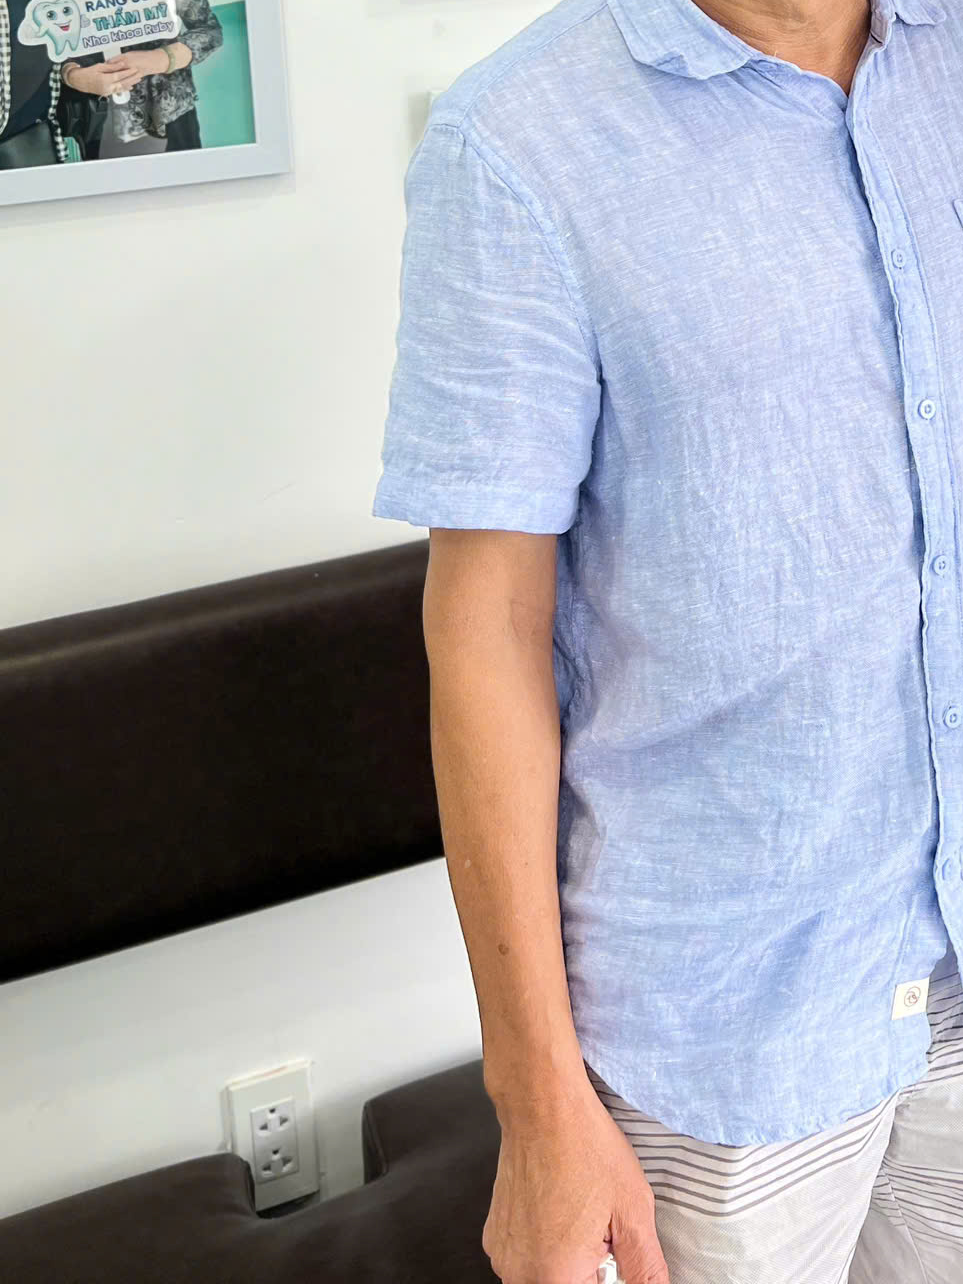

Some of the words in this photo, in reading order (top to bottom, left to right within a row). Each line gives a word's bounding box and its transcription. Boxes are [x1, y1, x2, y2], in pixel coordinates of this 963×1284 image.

[93, 6, 140, 31] THẨM
[143, 1, 168, 21] MỸ
[82, 35, 110, 48] Nha
[110, 28, 143, 42] khoa
[144, 21, 174, 35] Ruby
